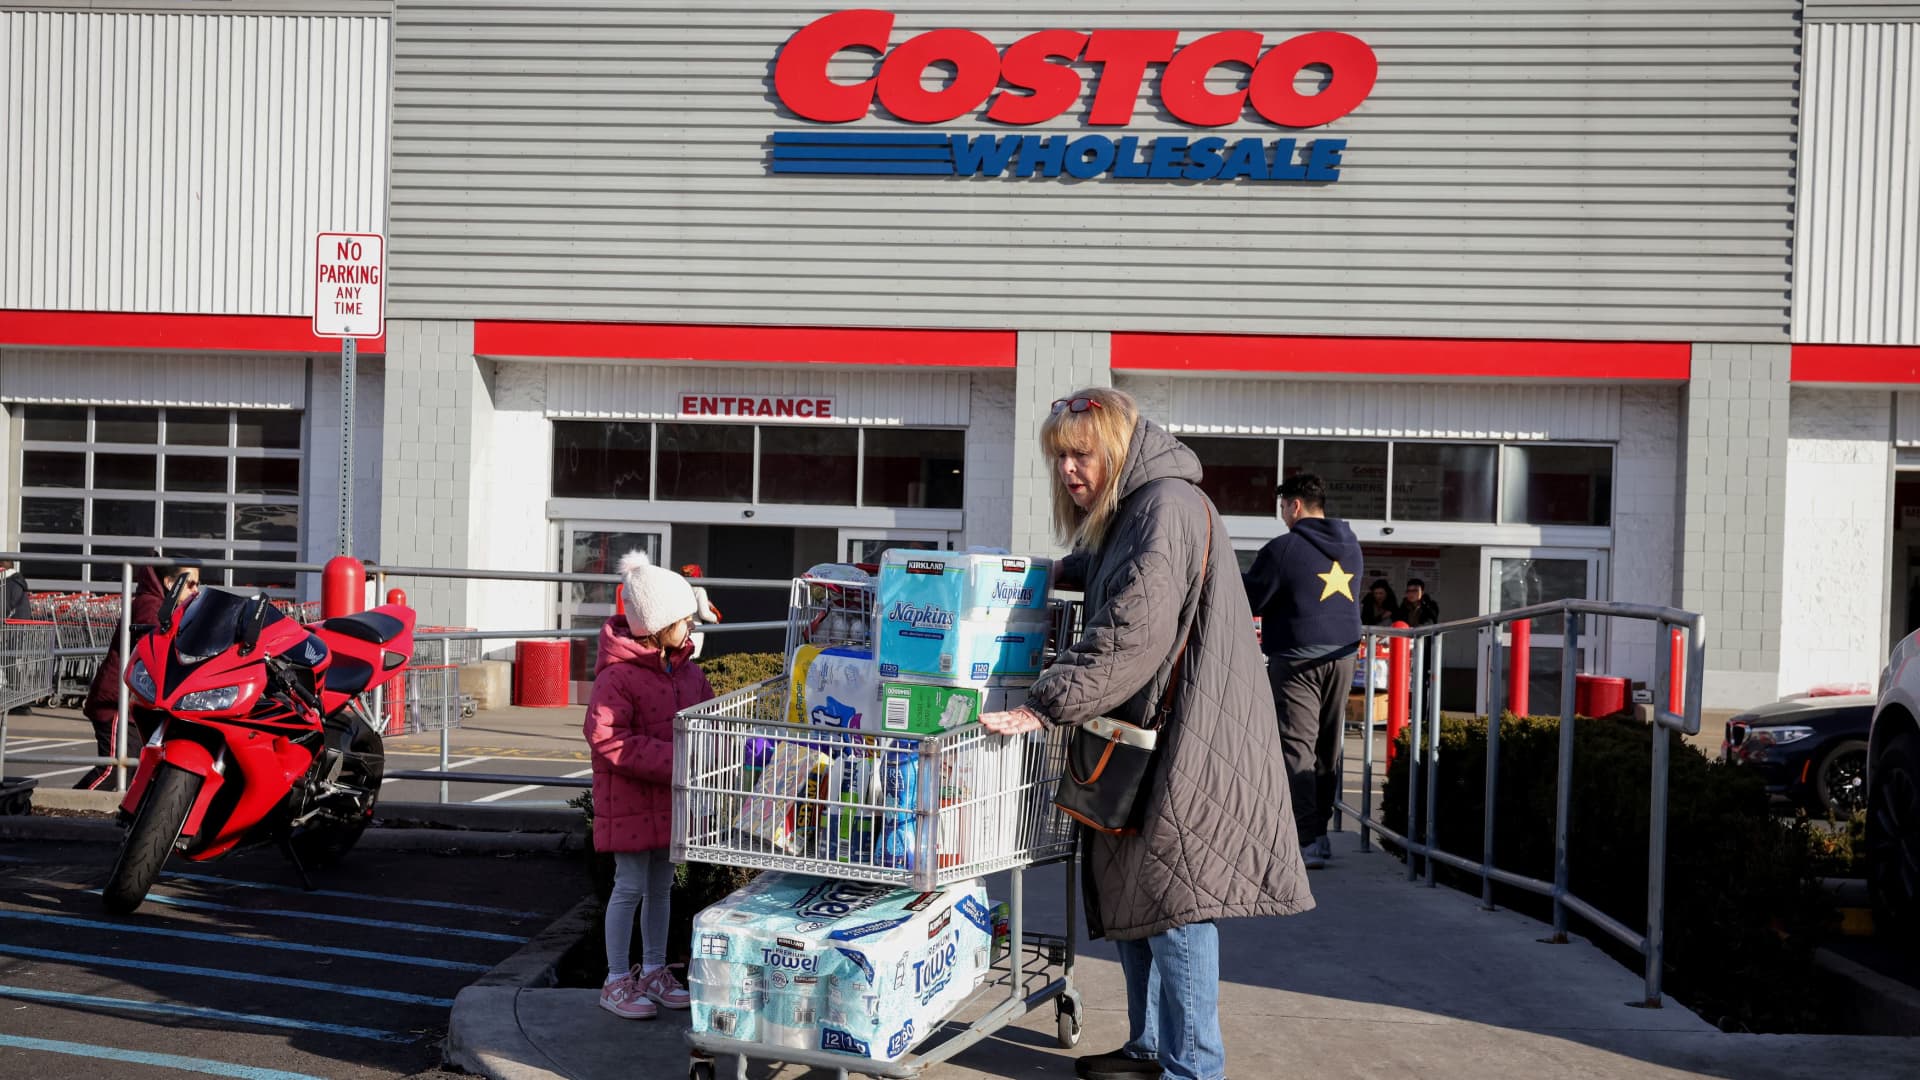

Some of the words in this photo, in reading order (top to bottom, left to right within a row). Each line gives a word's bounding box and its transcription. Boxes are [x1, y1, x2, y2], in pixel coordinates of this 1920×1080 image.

[774, 9, 1378, 126] COSTCO
[950, 134, 1347, 181] WHOLESALE
[337, 241, 362, 261] NO
[320, 264, 379, 284] PARKING
[336, 287, 361, 300] ANY
[334, 301, 363, 315] TIME
[682, 396, 832, 418] ENTRANCE
[908, 562, 944, 570] KIRKLAND
[992, 580, 1033, 603] Napkins
[889, 602, 954, 628] Napkins
[761, 949, 818, 973] Towel
[826, 1032, 840, 1045] 12
